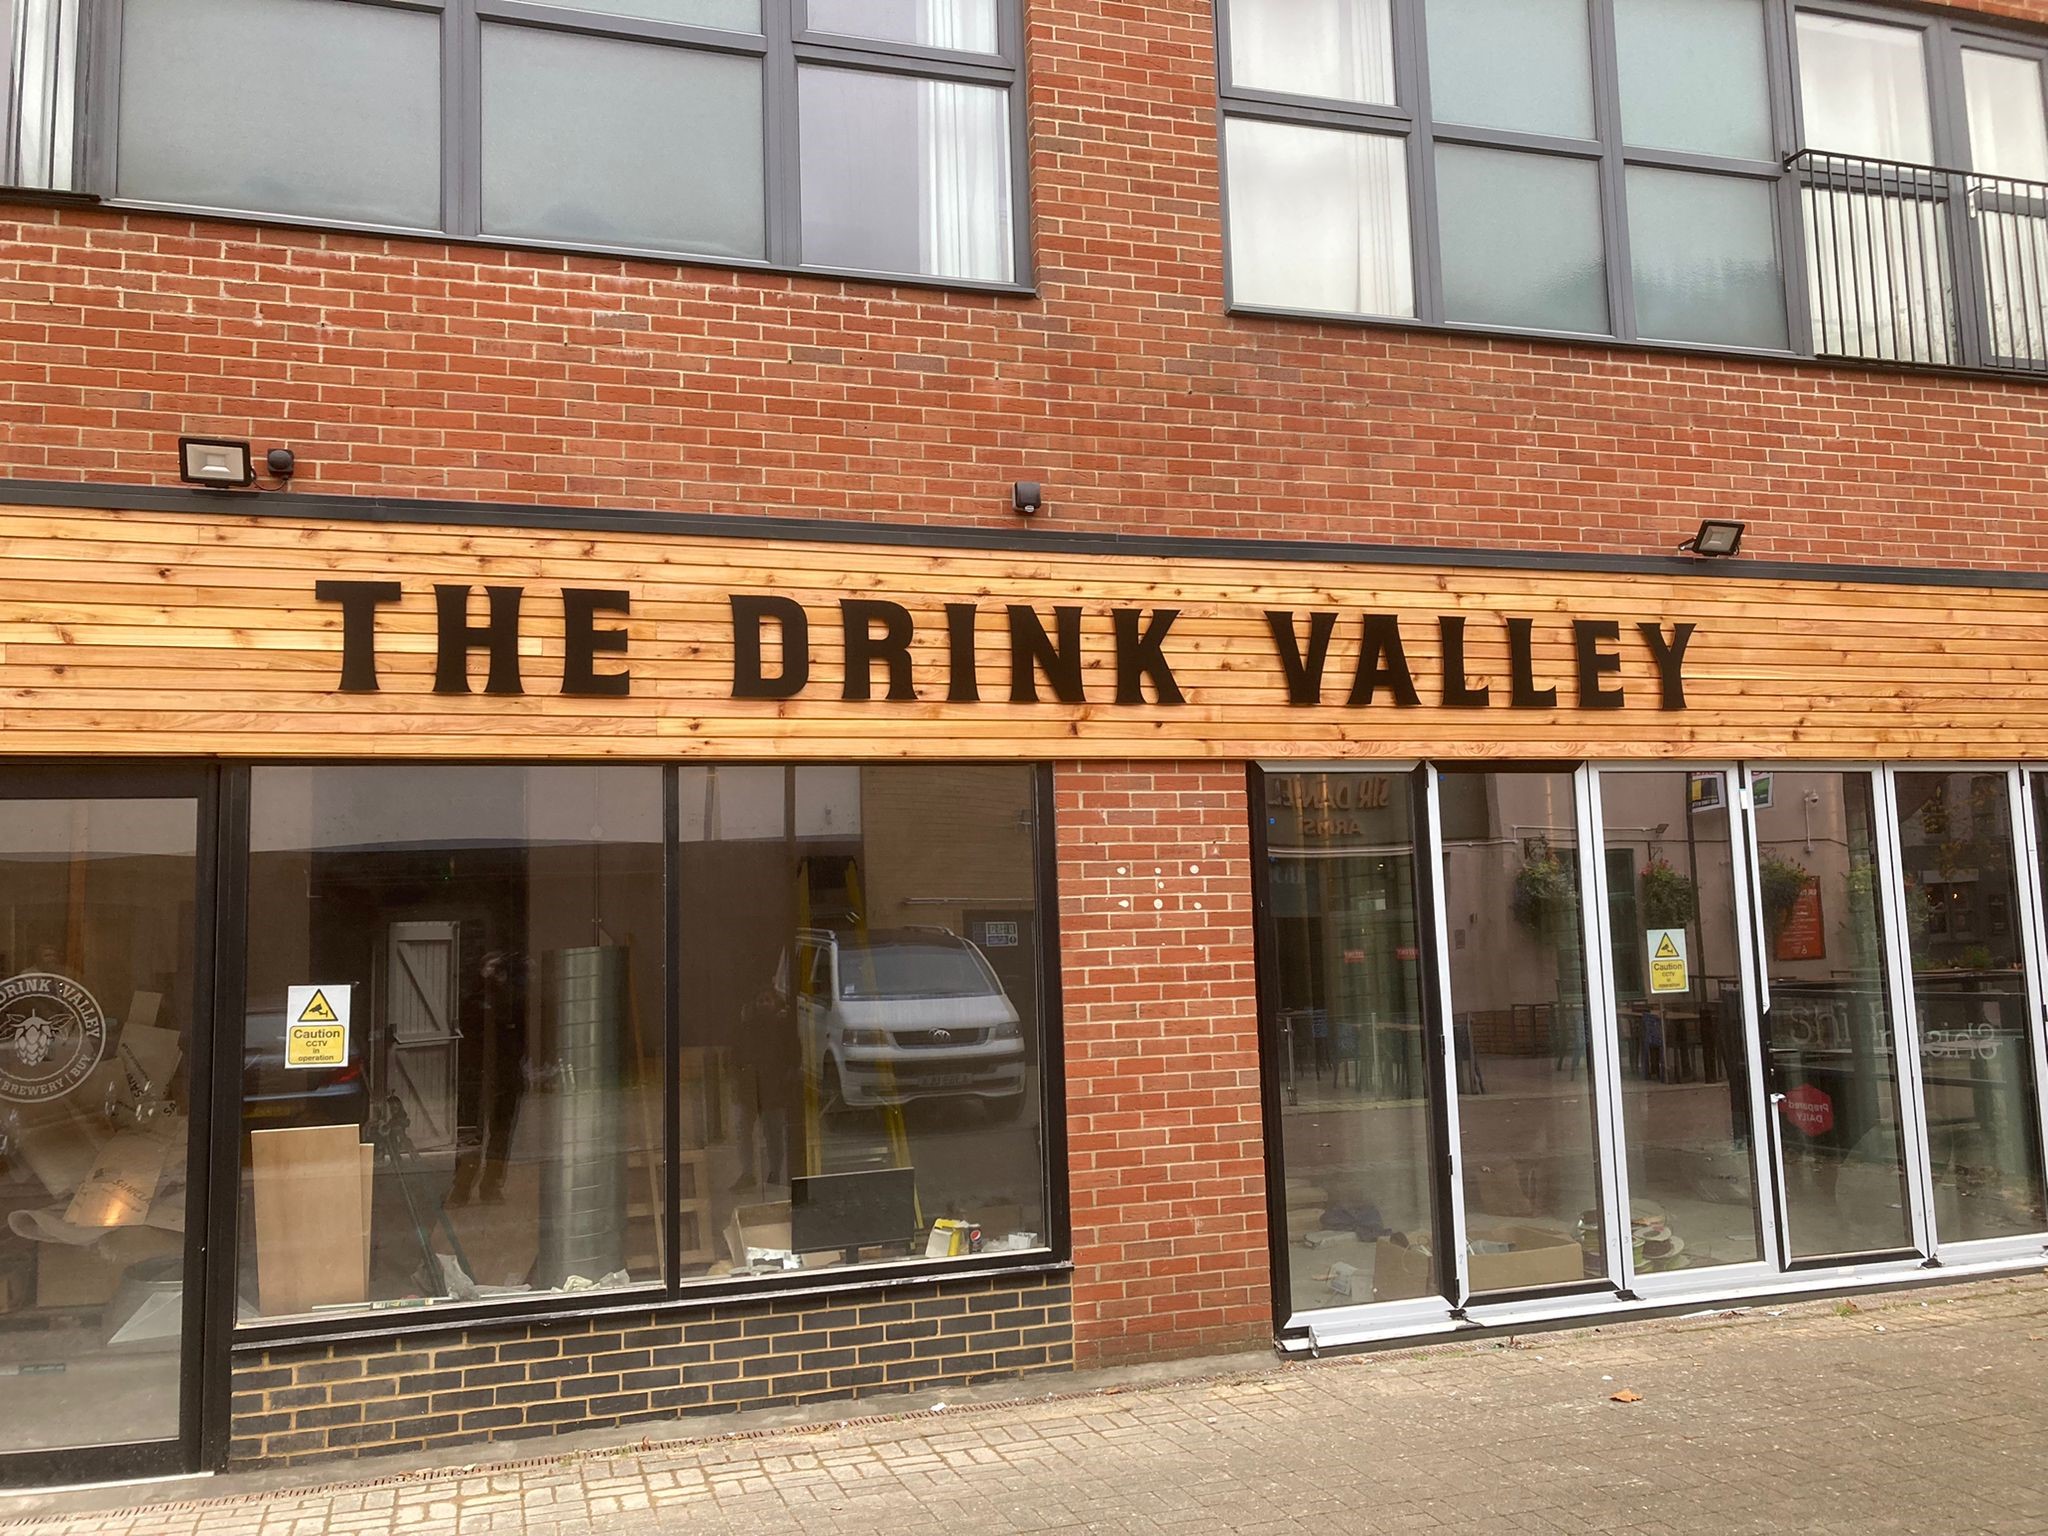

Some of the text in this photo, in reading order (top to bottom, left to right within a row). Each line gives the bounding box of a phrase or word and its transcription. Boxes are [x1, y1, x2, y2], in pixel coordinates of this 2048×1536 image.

[315, 580, 1697, 710] THE DRINK VALLEY
[1653, 962, 1683, 971] Caution
[61, 984, 101, 1039] VALLEY
[293, 1029, 341, 1039] Caution
[297, 1055, 335, 1063] operation
[1, 1054, 91, 1097] BREWERY BUY
